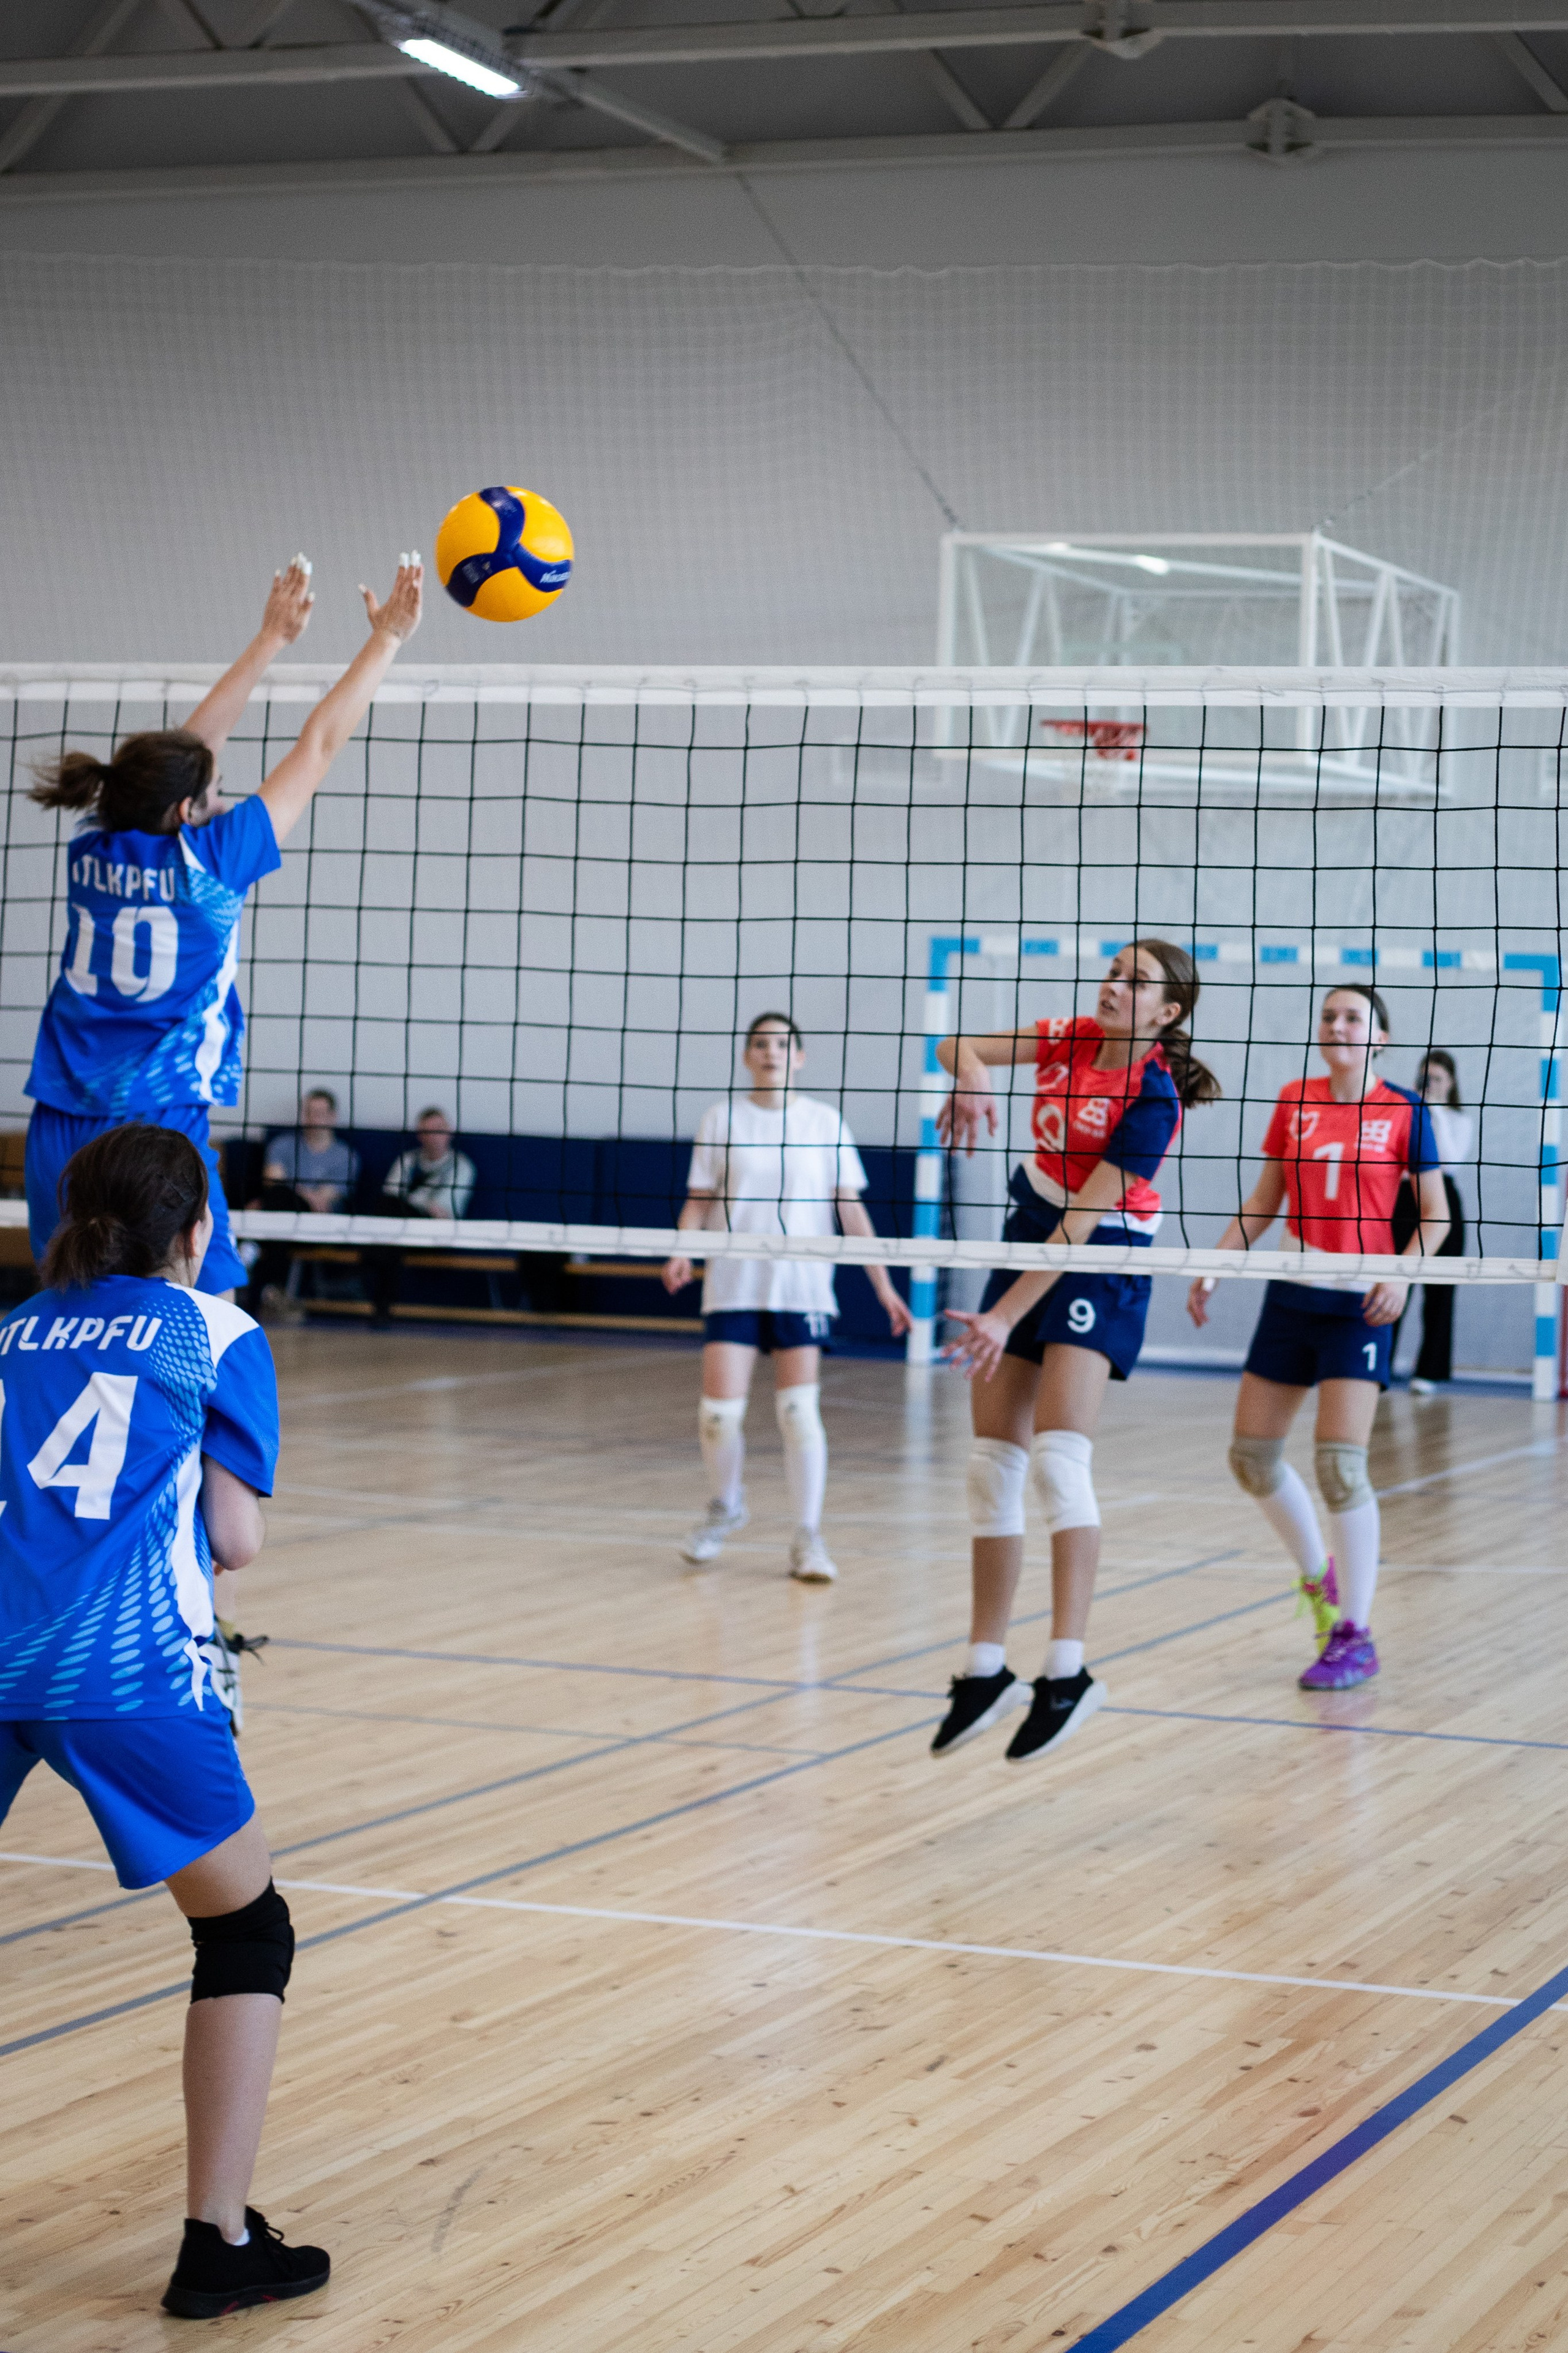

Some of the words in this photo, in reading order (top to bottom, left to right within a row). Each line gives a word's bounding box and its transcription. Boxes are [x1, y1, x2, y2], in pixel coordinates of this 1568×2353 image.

[65, 902, 179, 1003] 10
[1313, 1141, 1344, 1201] 1
[1067, 1297, 1096, 1334] 9
[1362, 1342, 1378, 1372] 1
[0, 1371, 138, 1520] 4
